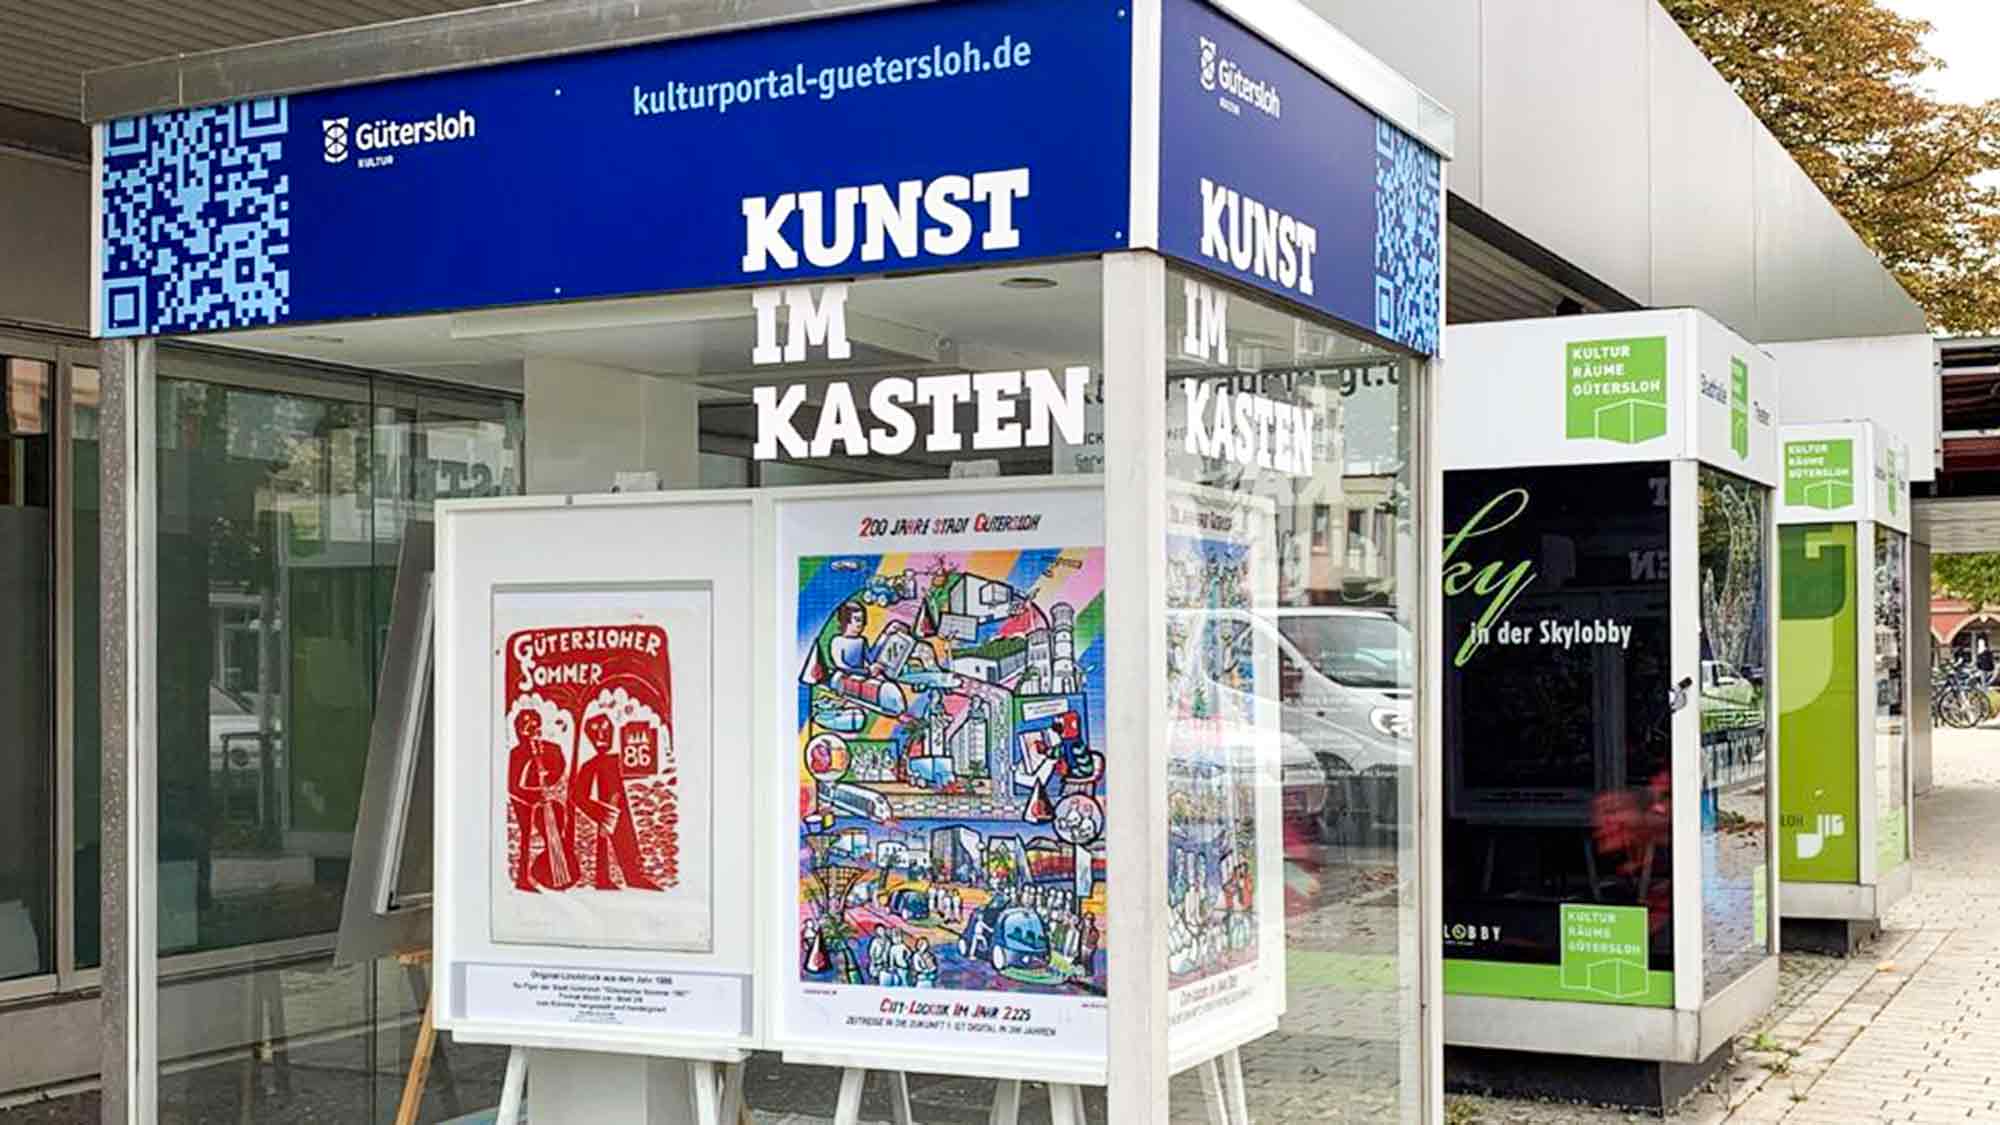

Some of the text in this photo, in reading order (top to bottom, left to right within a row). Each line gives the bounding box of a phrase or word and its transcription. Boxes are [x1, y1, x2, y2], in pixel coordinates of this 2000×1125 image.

[633, 34, 1031, 116] kulturportal-guetersloh.de
[1218, 58, 1280, 119] Gütersloh
[355, 109, 475, 150] Gütersloh
[742, 168, 1029, 272] KUNST
[1201, 177, 1316, 296] KUNST
[752, 283, 850, 365] IM
[1184, 279, 1228, 365] IM
[1572, 345, 1631, 360] KULTUR
[1572, 363, 1625, 379] RÄUME
[1572, 379, 1661, 397] GÜTERSLOH
[753, 366, 1089, 460] KASTEN
[1184, 377, 1313, 477] KASTEN
[859, 516, 888, 537] 200
[513, 629, 662, 661] GÜTERSLOHER
[1498, 621, 1532, 645] der
[1540, 619, 1632, 649] Skylobby
[518, 660, 603, 692] SOMMER
[623, 745, 651, 767] 86
[1443, 923, 1502, 942] LOBBY
